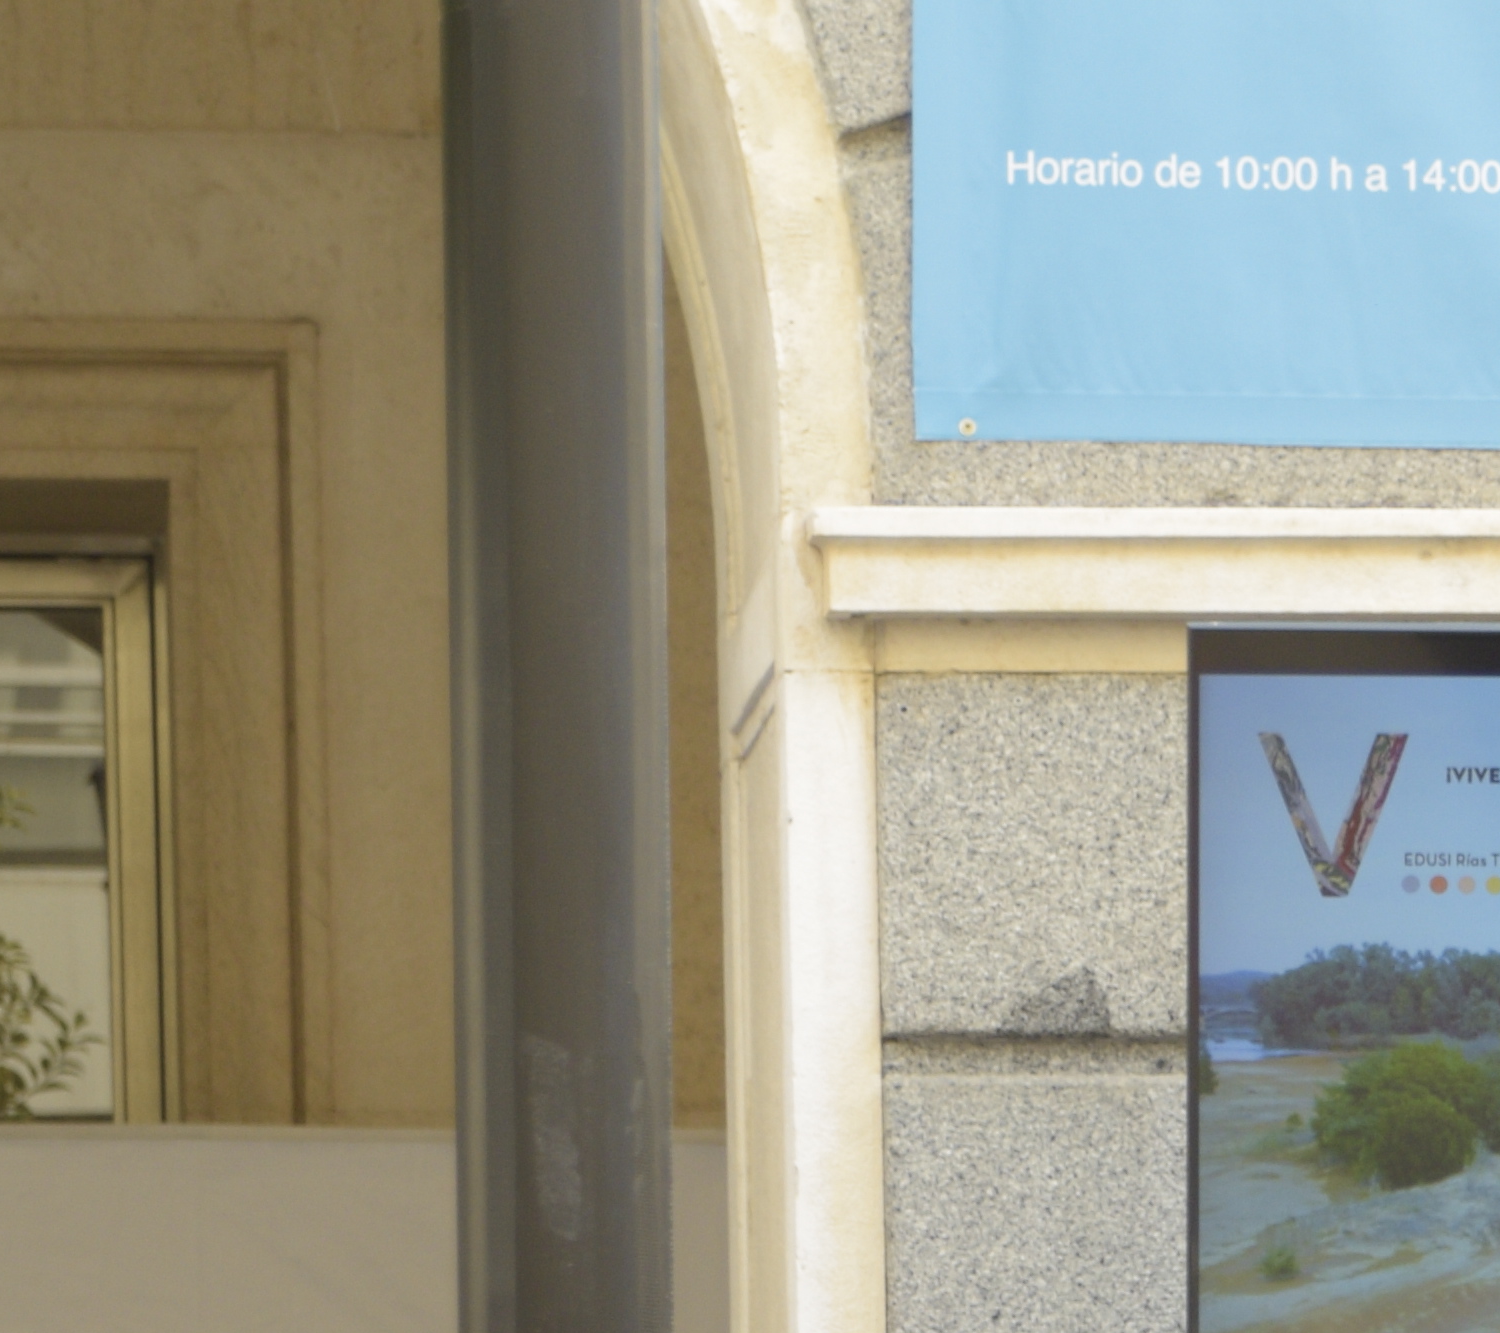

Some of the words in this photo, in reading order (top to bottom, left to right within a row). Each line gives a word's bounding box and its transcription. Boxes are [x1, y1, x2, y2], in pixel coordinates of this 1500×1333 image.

[1005, 148, 1145, 189] Horario
[1152, 151, 1203, 190] de
[1214, 154, 1320, 193] 10:00
[1328, 155, 1354, 192] h
[1363, 162, 1390, 194] a
[1445, 766, 1500, 785] ¡VIVE
[1403, 851, 1452, 868] EDUSI
[1455, 851, 1487, 868] Rías
